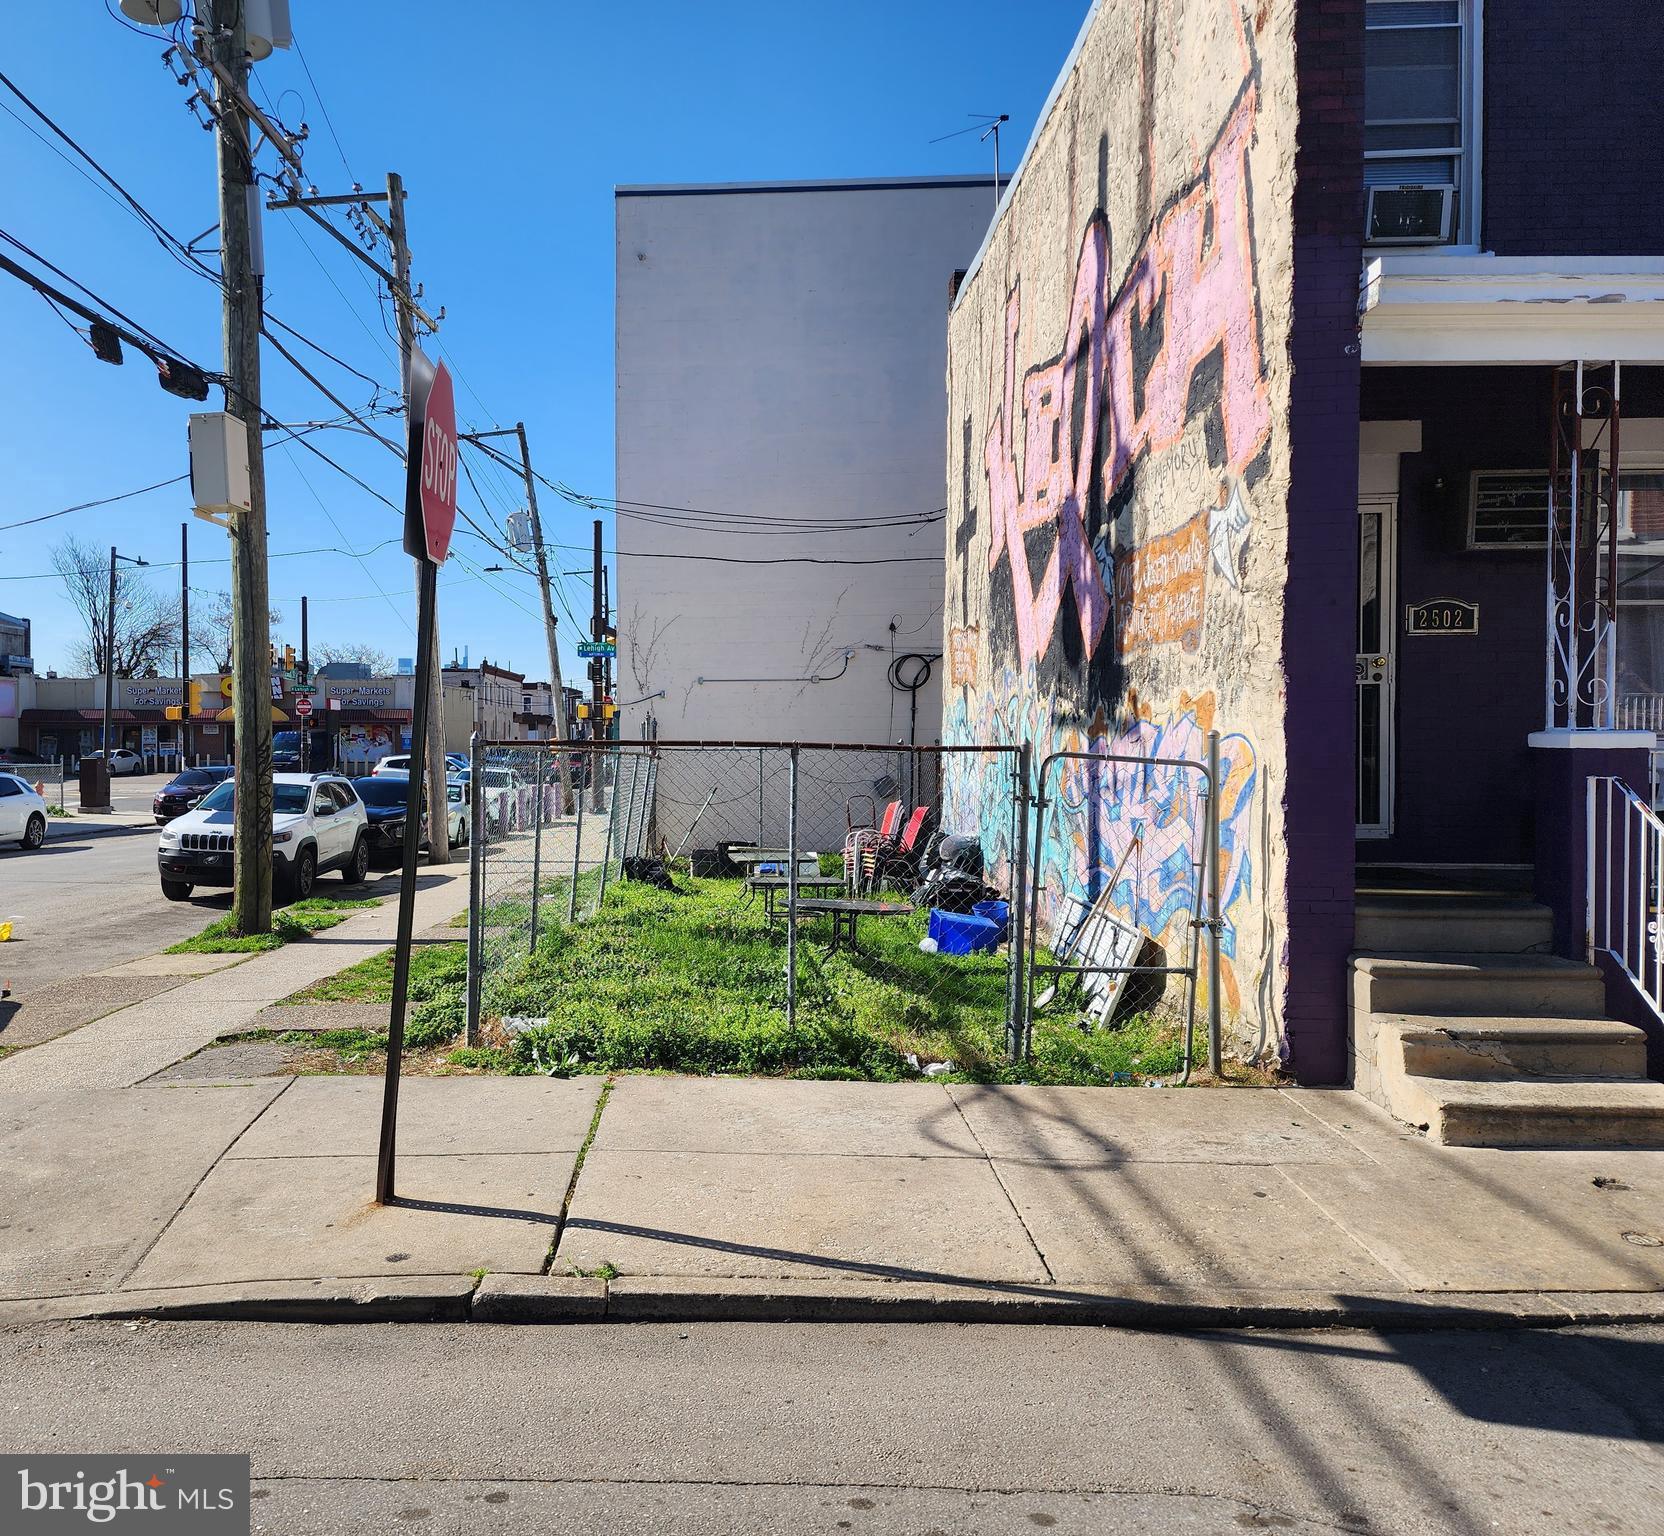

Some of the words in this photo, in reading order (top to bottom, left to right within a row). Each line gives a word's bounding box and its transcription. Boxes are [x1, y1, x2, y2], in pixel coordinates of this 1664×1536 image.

[425, 416, 456, 506] STOP
[1419, 609, 1463, 627] 2502
[583, 644, 605, 652] Lehigh
[126, 686, 150, 696] Super
[154, 686, 182, 695] Market
[330, 686, 354, 696] Super
[359, 686, 391, 695] Markets
[133, 697, 147, 705] For
[149, 697, 181, 706] Savings
[351, 697, 384, 707] Savings
